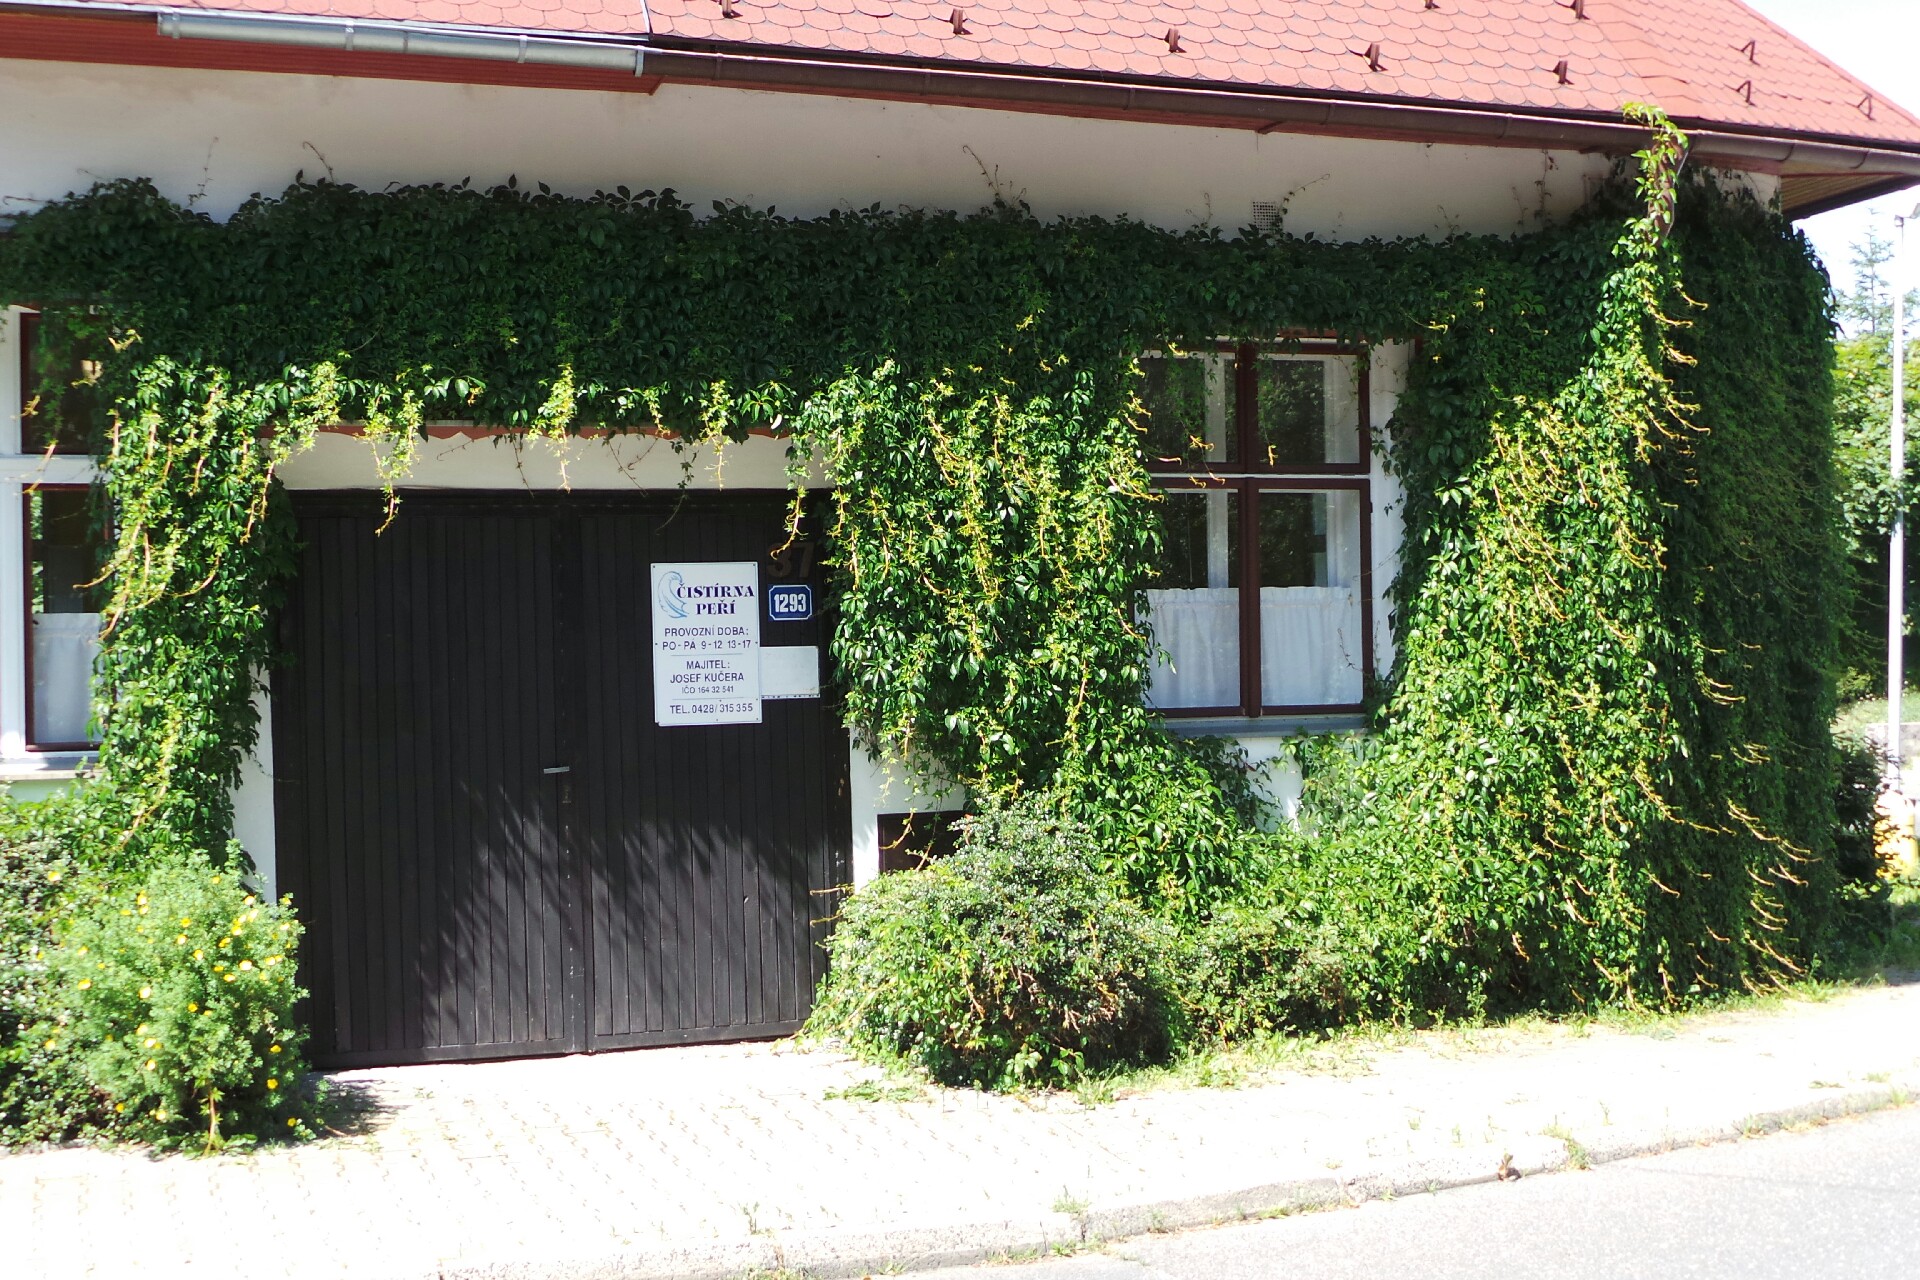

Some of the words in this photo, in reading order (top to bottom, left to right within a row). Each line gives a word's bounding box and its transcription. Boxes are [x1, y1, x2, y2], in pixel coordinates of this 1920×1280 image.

[677, 583, 755, 599] ČISTÍRNA
[696, 599, 736, 615] PEŘÍ
[774, 594, 807, 613] 1293
[664, 625, 715, 637] PROVOZNÍ
[717, 627, 749, 636] DOBA:
[686, 660, 730, 670] MAJITEL:
[670, 674, 701, 684] JOSEF
[705, 671, 744, 682] KUČERA
[698, 686, 710, 694] 164
